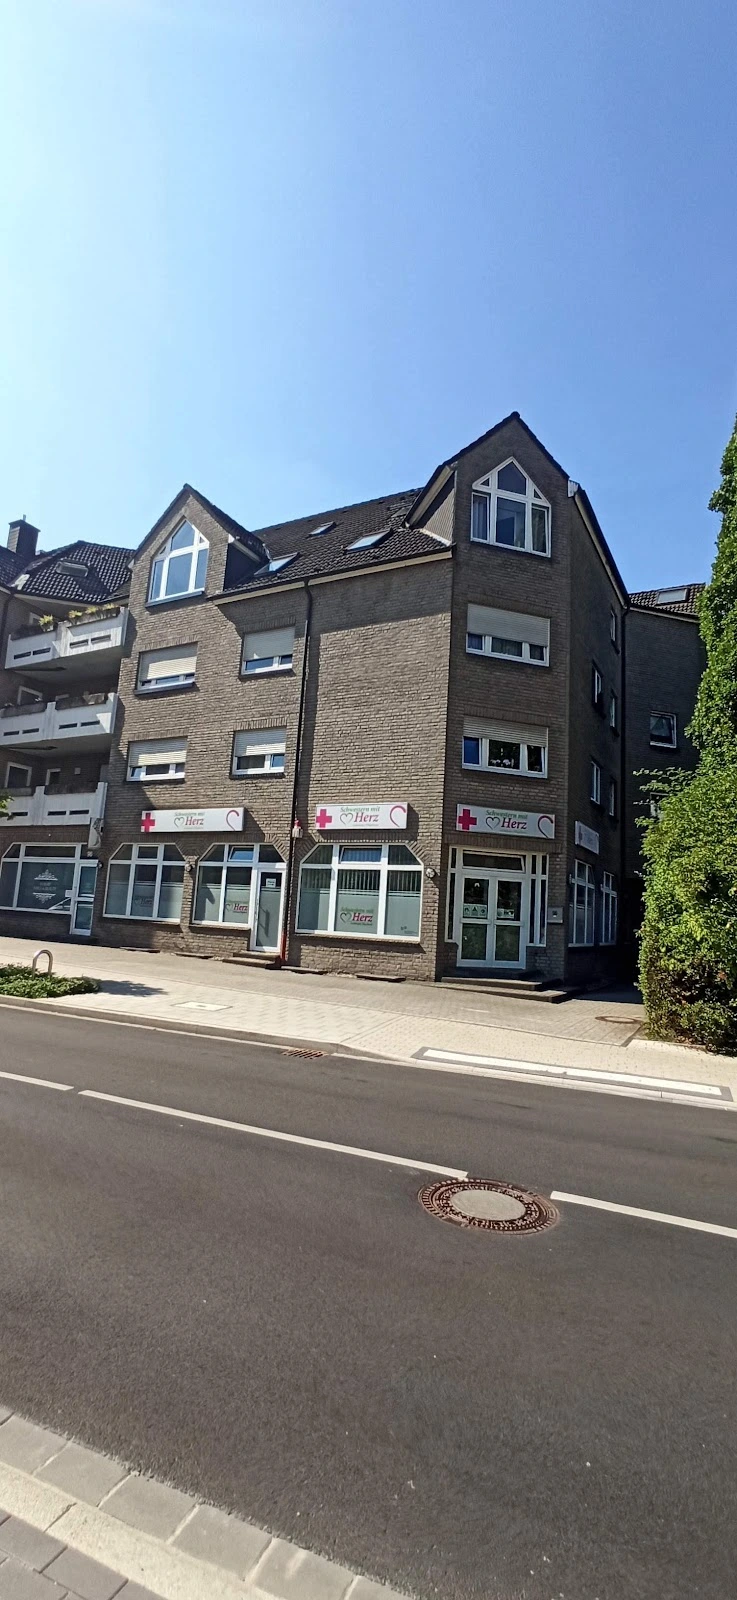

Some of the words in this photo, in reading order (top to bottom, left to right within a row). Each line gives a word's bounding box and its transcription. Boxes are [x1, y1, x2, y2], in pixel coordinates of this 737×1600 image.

[353, 812, 379, 823] Herz
[486, 810, 517, 819] Schwestern
[185, 816, 204, 826] Herz
[501, 817, 527, 830] Herz
[233, 903, 248, 912] Herz
[352, 912, 373, 922] Herz
